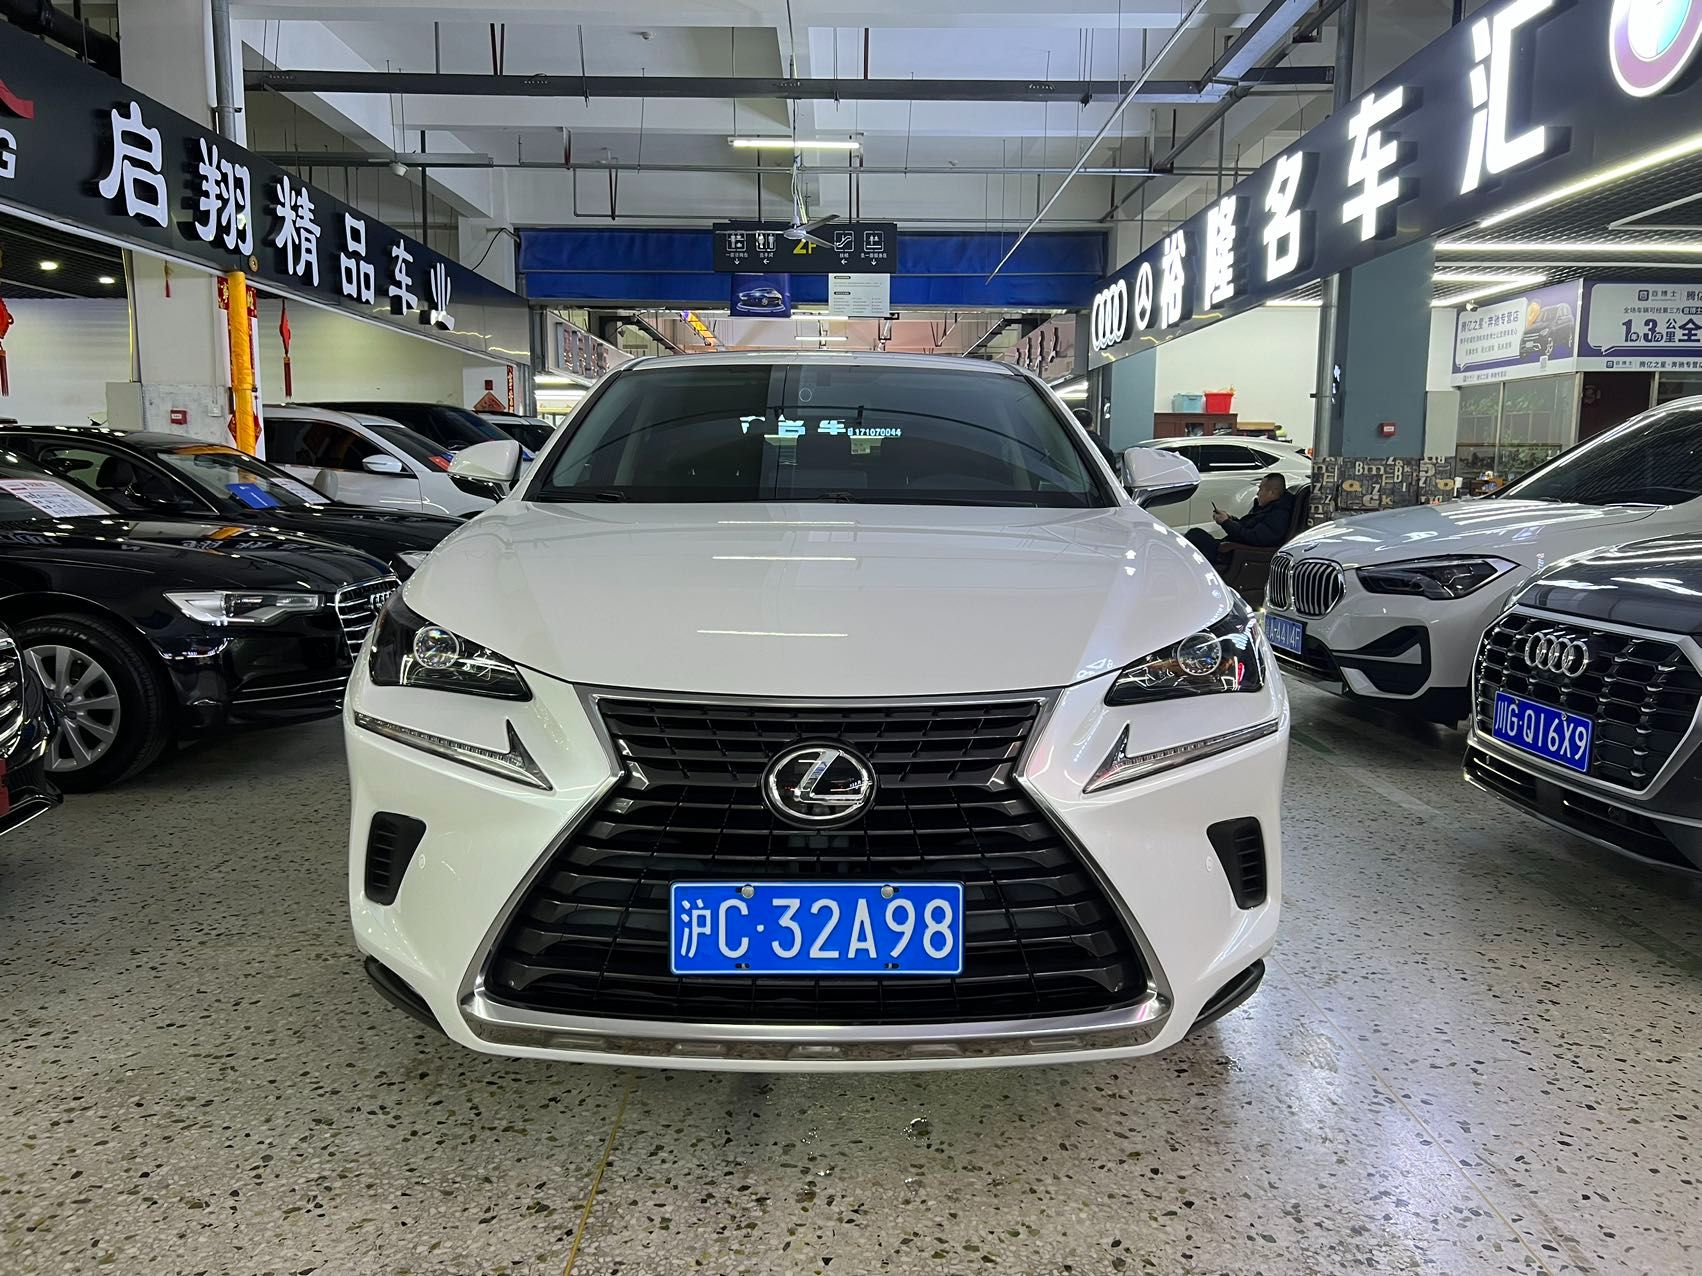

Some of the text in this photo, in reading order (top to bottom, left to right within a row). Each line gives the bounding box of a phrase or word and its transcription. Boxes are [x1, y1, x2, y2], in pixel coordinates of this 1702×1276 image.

[98, 100, 455, 331] 启翔精品车业
[1160, 0, 1552, 329] 裕隆名车汇
[1495, 700, 1587, 760] 川G·Q16X9
[680, 898, 954, 959] 沪C·32A98
